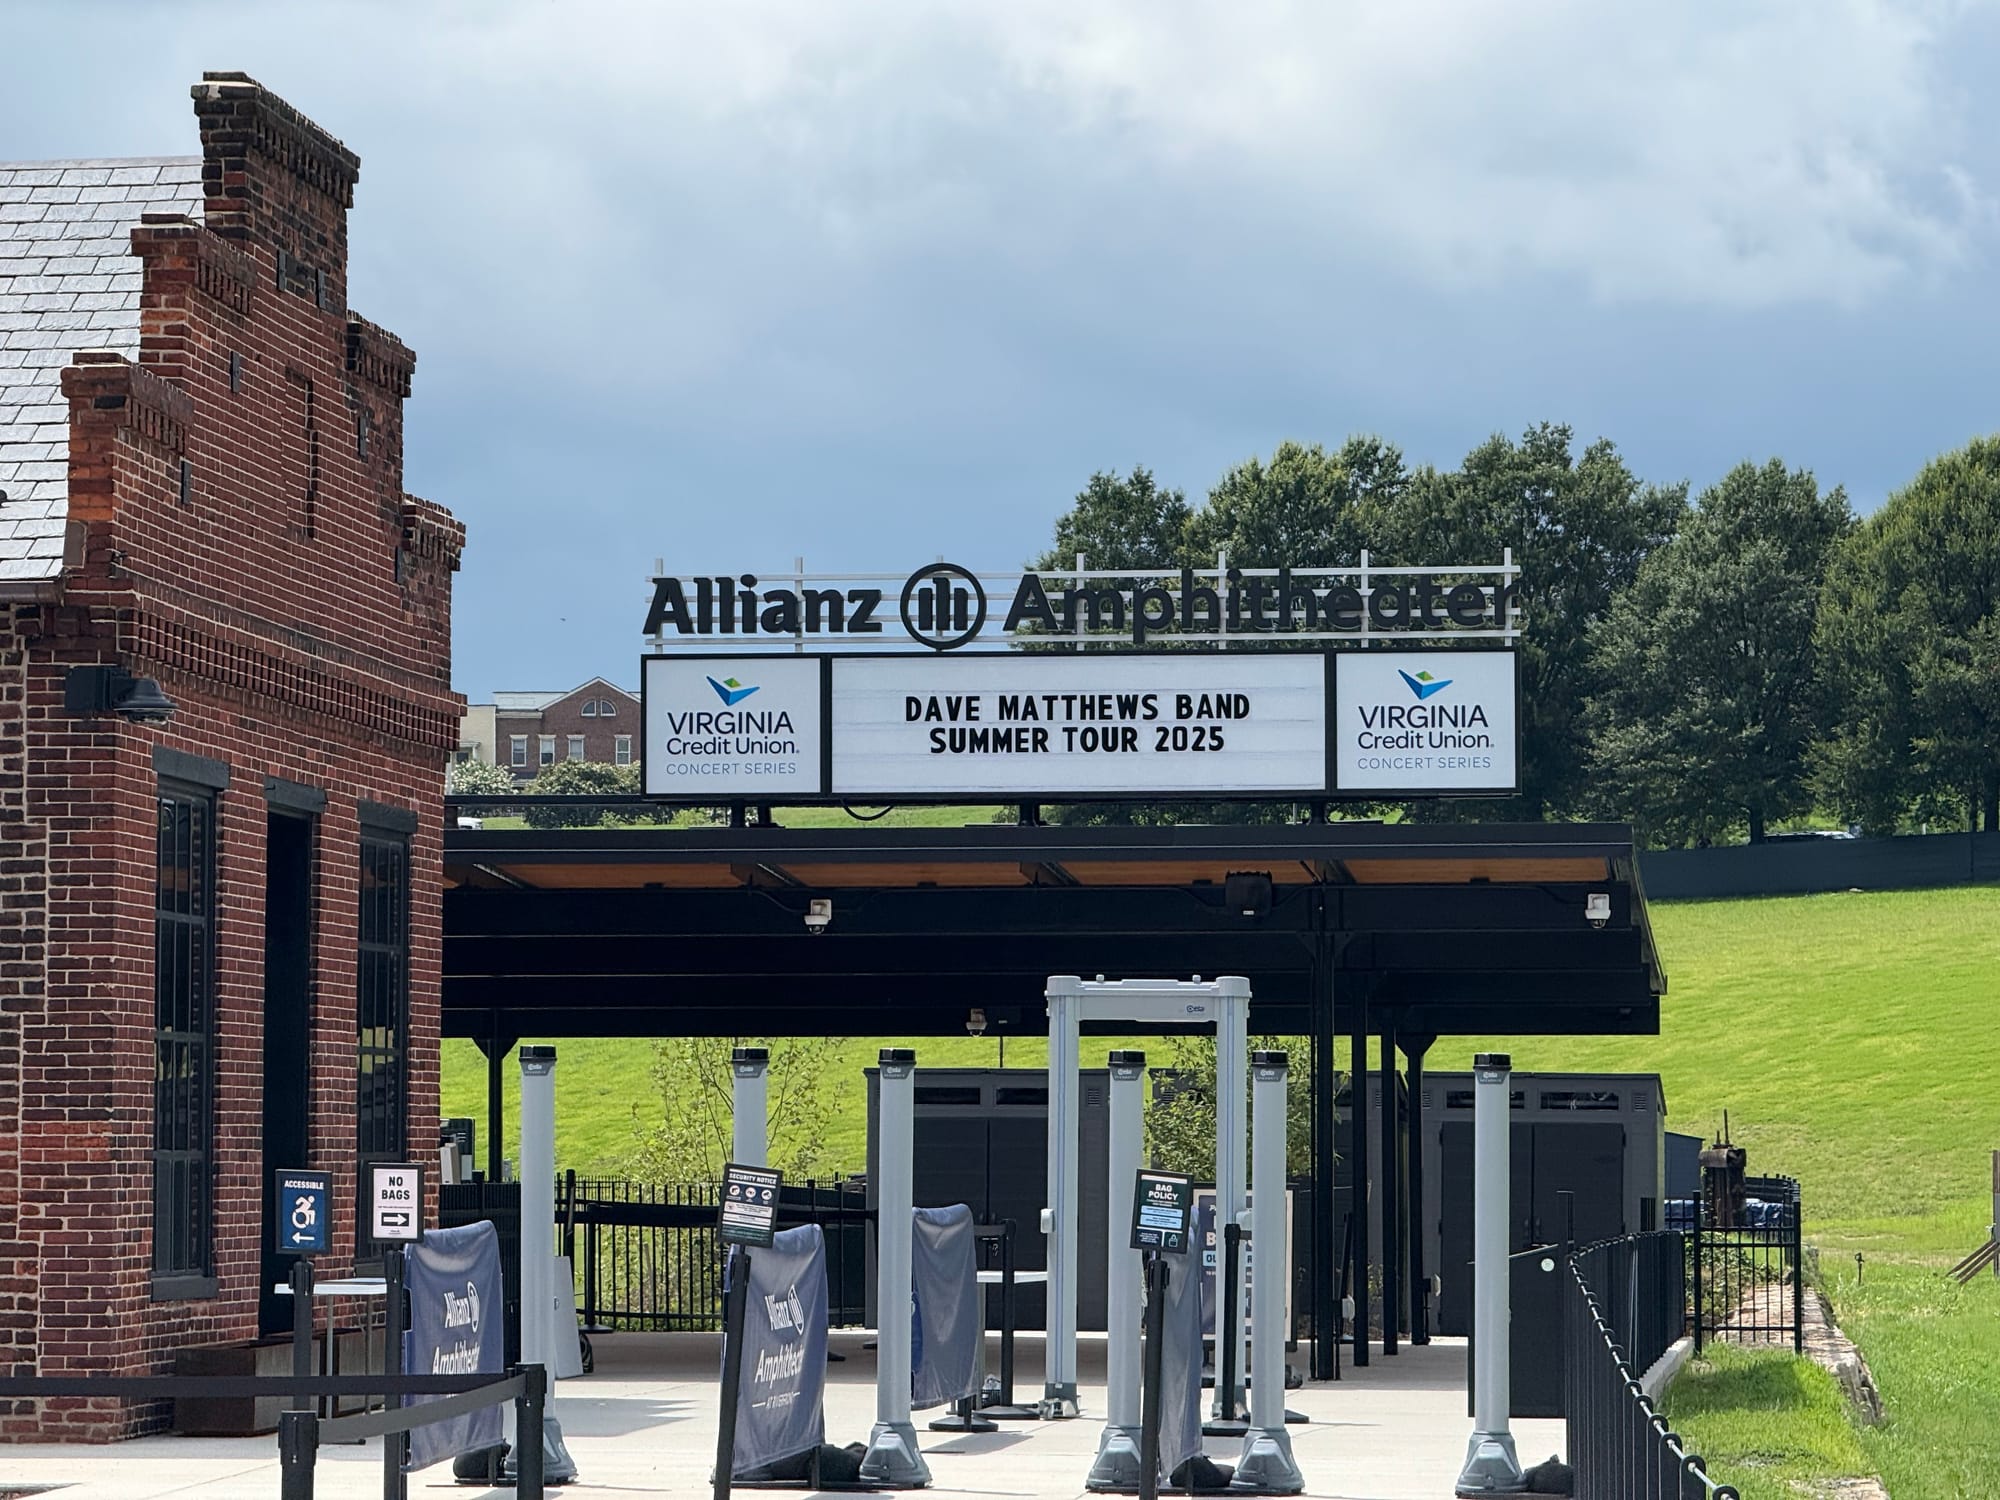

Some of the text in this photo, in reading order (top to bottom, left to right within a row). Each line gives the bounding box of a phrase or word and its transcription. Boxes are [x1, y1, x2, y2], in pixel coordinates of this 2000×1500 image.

[643, 568, 1519, 643] Allianz Amphitheater
[905, 693, 1250, 721] DAVE MATTHEWS BAND
[667, 711, 794, 735] VIRGINIA
[1358, 704, 1489, 729] VIRGINIA
[666, 736, 731, 756] Credit
[930, 726, 1225, 754] SUMMER TOUR 2025
[1358, 730, 1424, 750] Credit
[666, 762, 796, 775] CONCERT SERIES
[1357, 757, 1491, 770] CONCERT SERIES
[284, 1180, 324, 1190] ACCESSIBLE
[388, 1176, 403, 1187] NO
[729, 1173, 777, 1185] SECURITY NOTICE
[381, 1189, 410, 1200] BAGS
[1148, 1191, 1179, 1201] POLICY
[1155, 1184, 1172, 1192] BAG
[765, 1295, 793, 1331] Allianz
